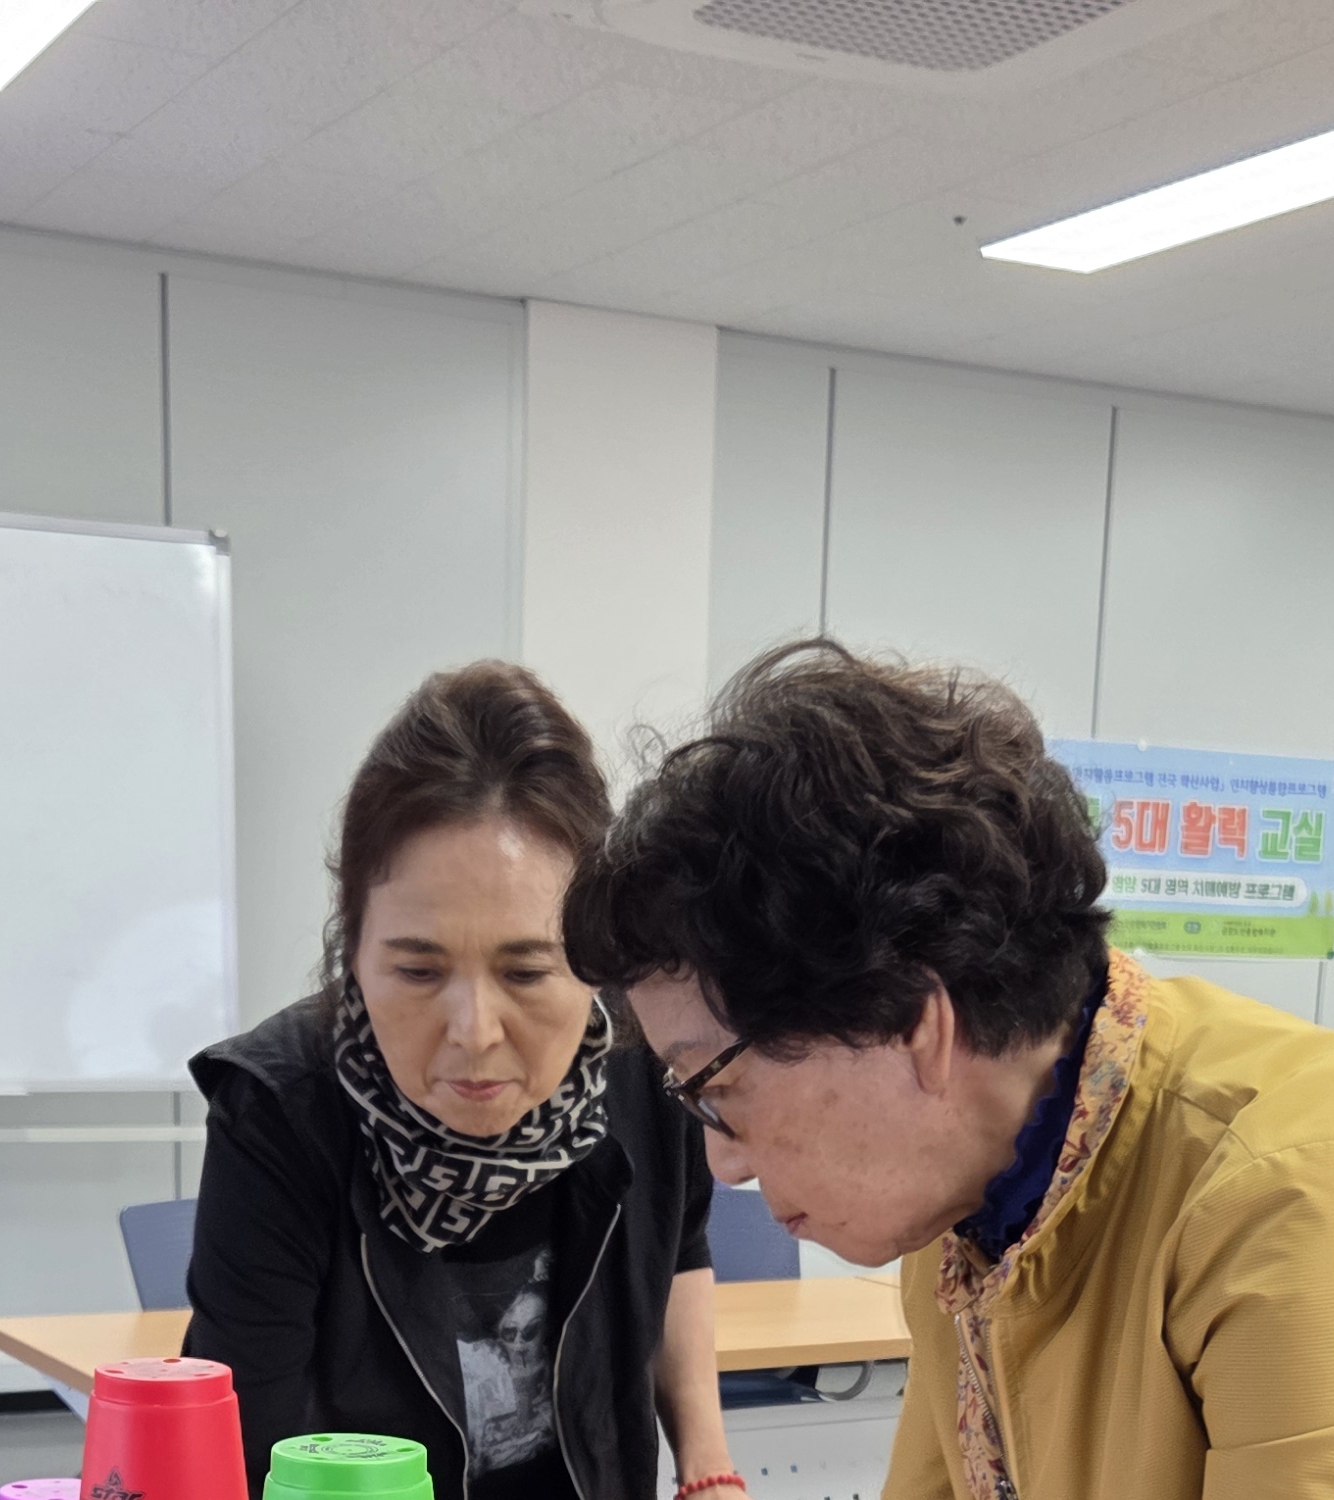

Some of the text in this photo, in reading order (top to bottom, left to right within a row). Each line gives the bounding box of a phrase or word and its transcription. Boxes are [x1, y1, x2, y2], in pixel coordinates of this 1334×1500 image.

[1112, 799, 1171, 854] 5대
[1179, 799, 1249, 859] 활력
[1258, 807, 1324, 862] 교실
[1141, 877, 1162, 895] 5대
[1165, 878, 1189, 896] 영역
[1192, 880, 1241, 898] 치매예방
[1243, 882, 1296, 901] 프로그램
